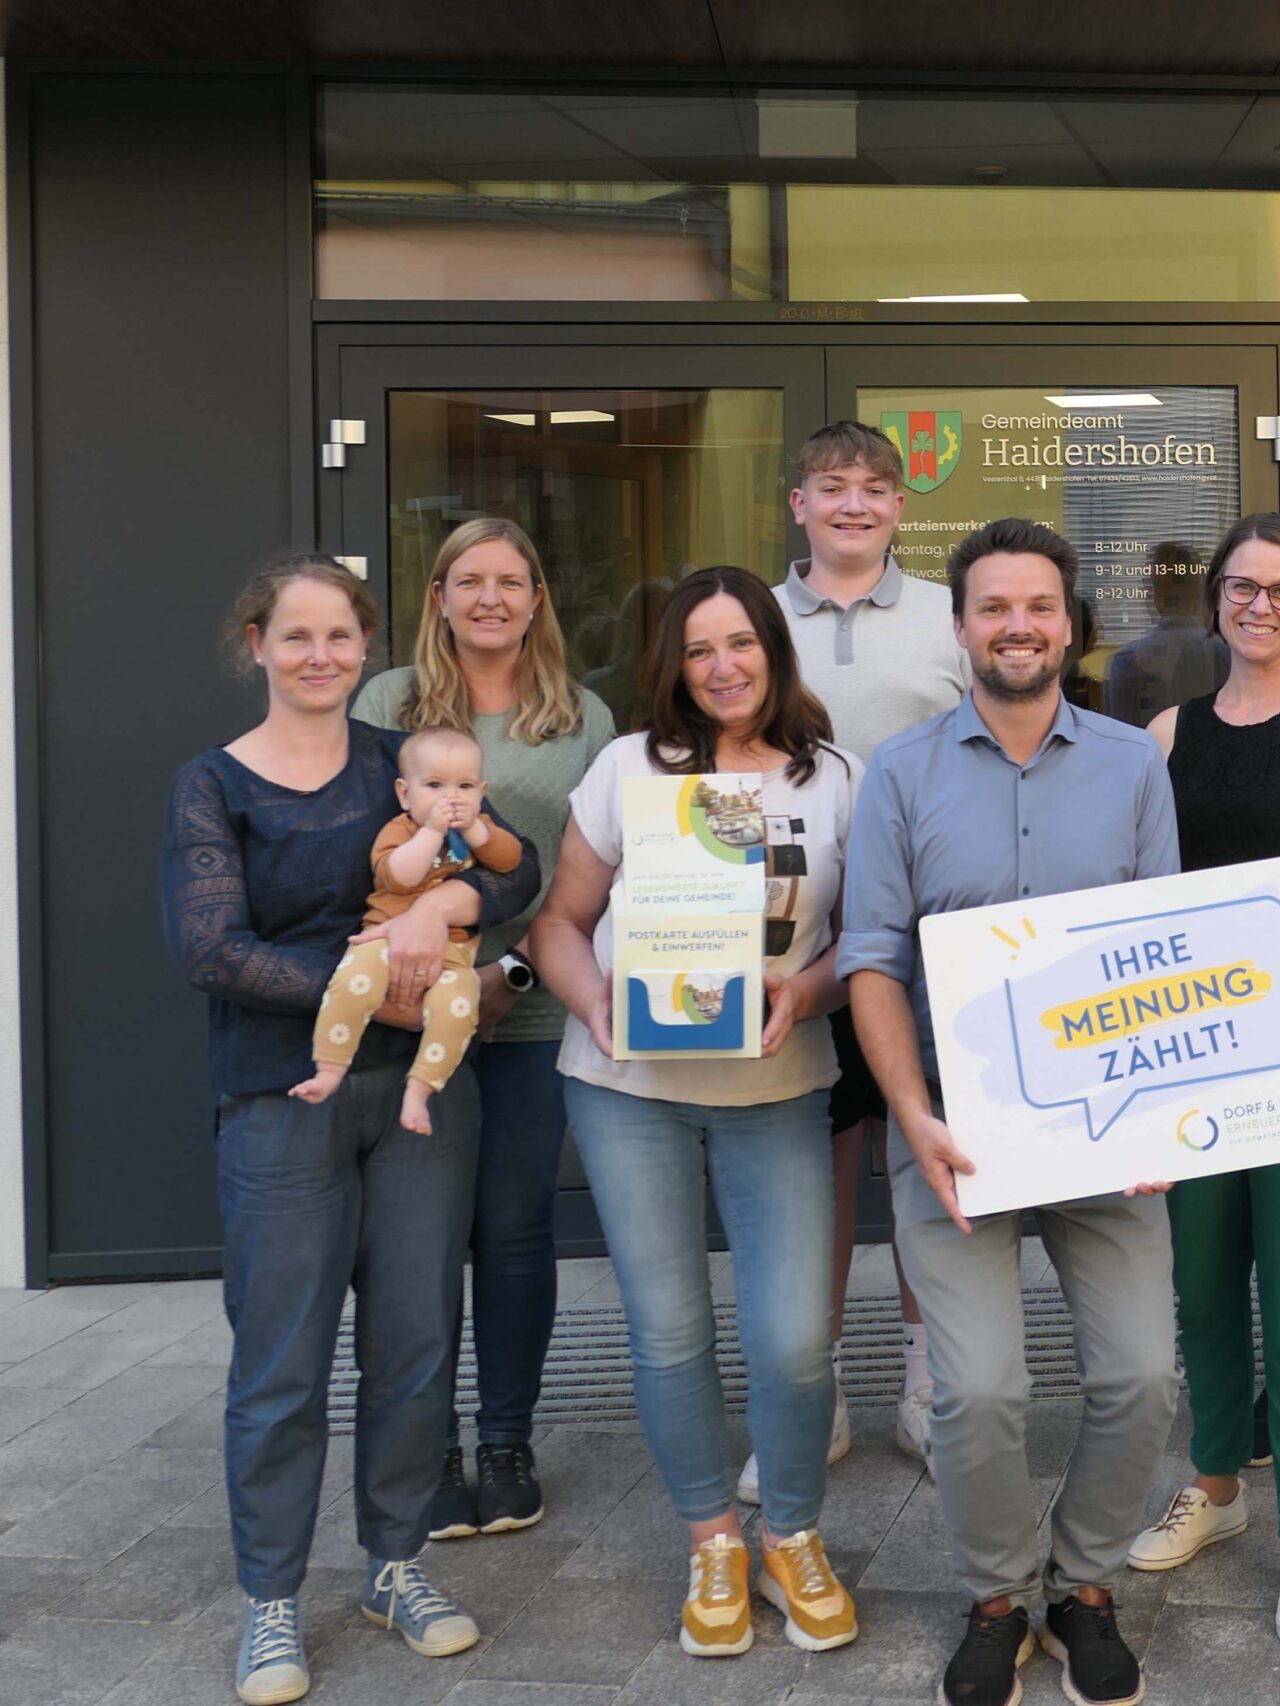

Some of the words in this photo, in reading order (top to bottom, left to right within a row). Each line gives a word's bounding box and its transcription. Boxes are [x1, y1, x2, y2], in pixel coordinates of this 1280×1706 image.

[981, 412, 1124, 430] Gemeindeamt
[981, 434, 1218, 467] Haidershofen
[1041, 474, 1085, 482] aidershofen
[890, 543, 945, 558] Montag,
[1095, 541, 1122, 552] 8-12
[1125, 541, 1148, 552] Uhr
[1095, 564, 1122, 576] 9-12
[1125, 564, 1152, 575] und
[1154, 563, 1186, 575] 13-18
[1095, 588, 1122, 599] 8-12
[1126, 587, 1149, 599] Uhr
[652, 893, 681, 904] DEINE
[628, 930, 688, 940] POSTKARTE
[690, 928, 749, 939] AUSFÜLLEN
[652, 944, 659, 952] &
[662, 942, 725, 951] EINWERFEN!
[1099, 931, 1193, 982] IHRE
[1060, 965, 1255, 1043] MEINUNG
[1097, 1018, 1240, 1083] ZÄHLT!
[1223, 1101, 1263, 1120] DORF
[1266, 1099, 1276, 1112] &
